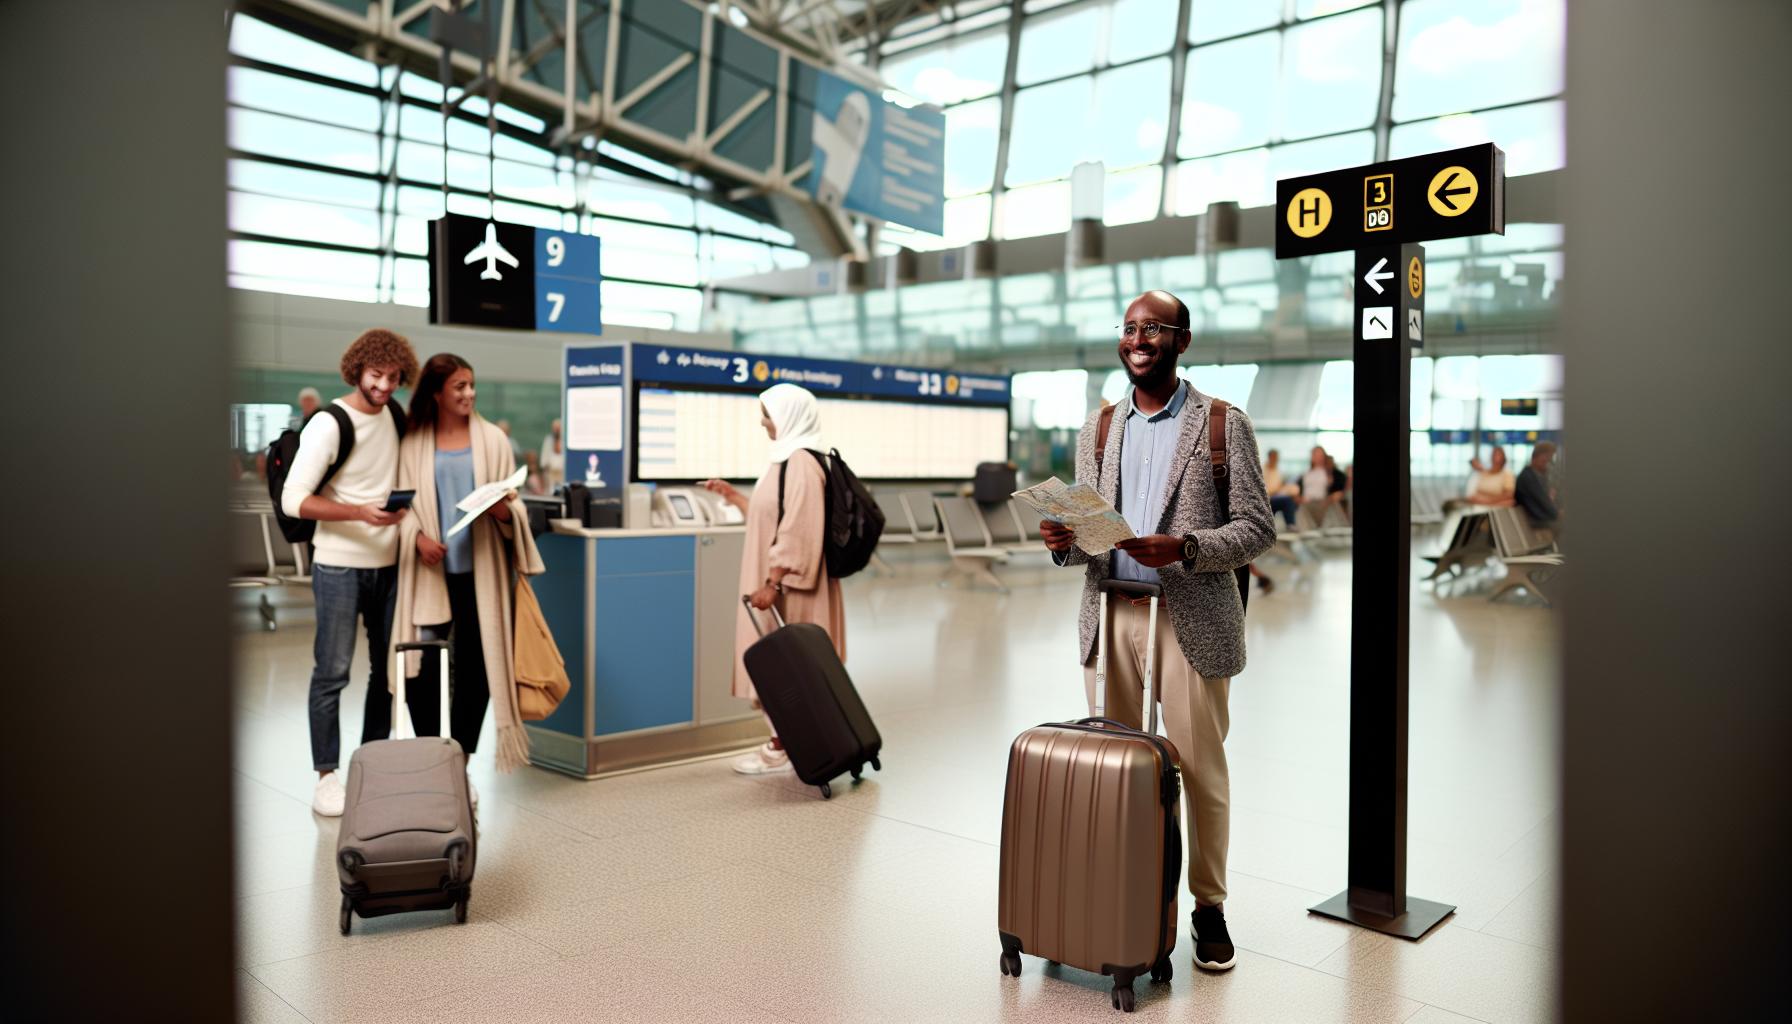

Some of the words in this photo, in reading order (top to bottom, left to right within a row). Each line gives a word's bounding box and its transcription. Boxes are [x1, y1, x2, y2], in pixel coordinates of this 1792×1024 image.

[1374, 181, 1386, 203] 3
[1299, 197, 1321, 228] H
[546, 236, 566, 267] 9
[546, 292, 566, 323] 7
[732, 357, 749, 383] 3
